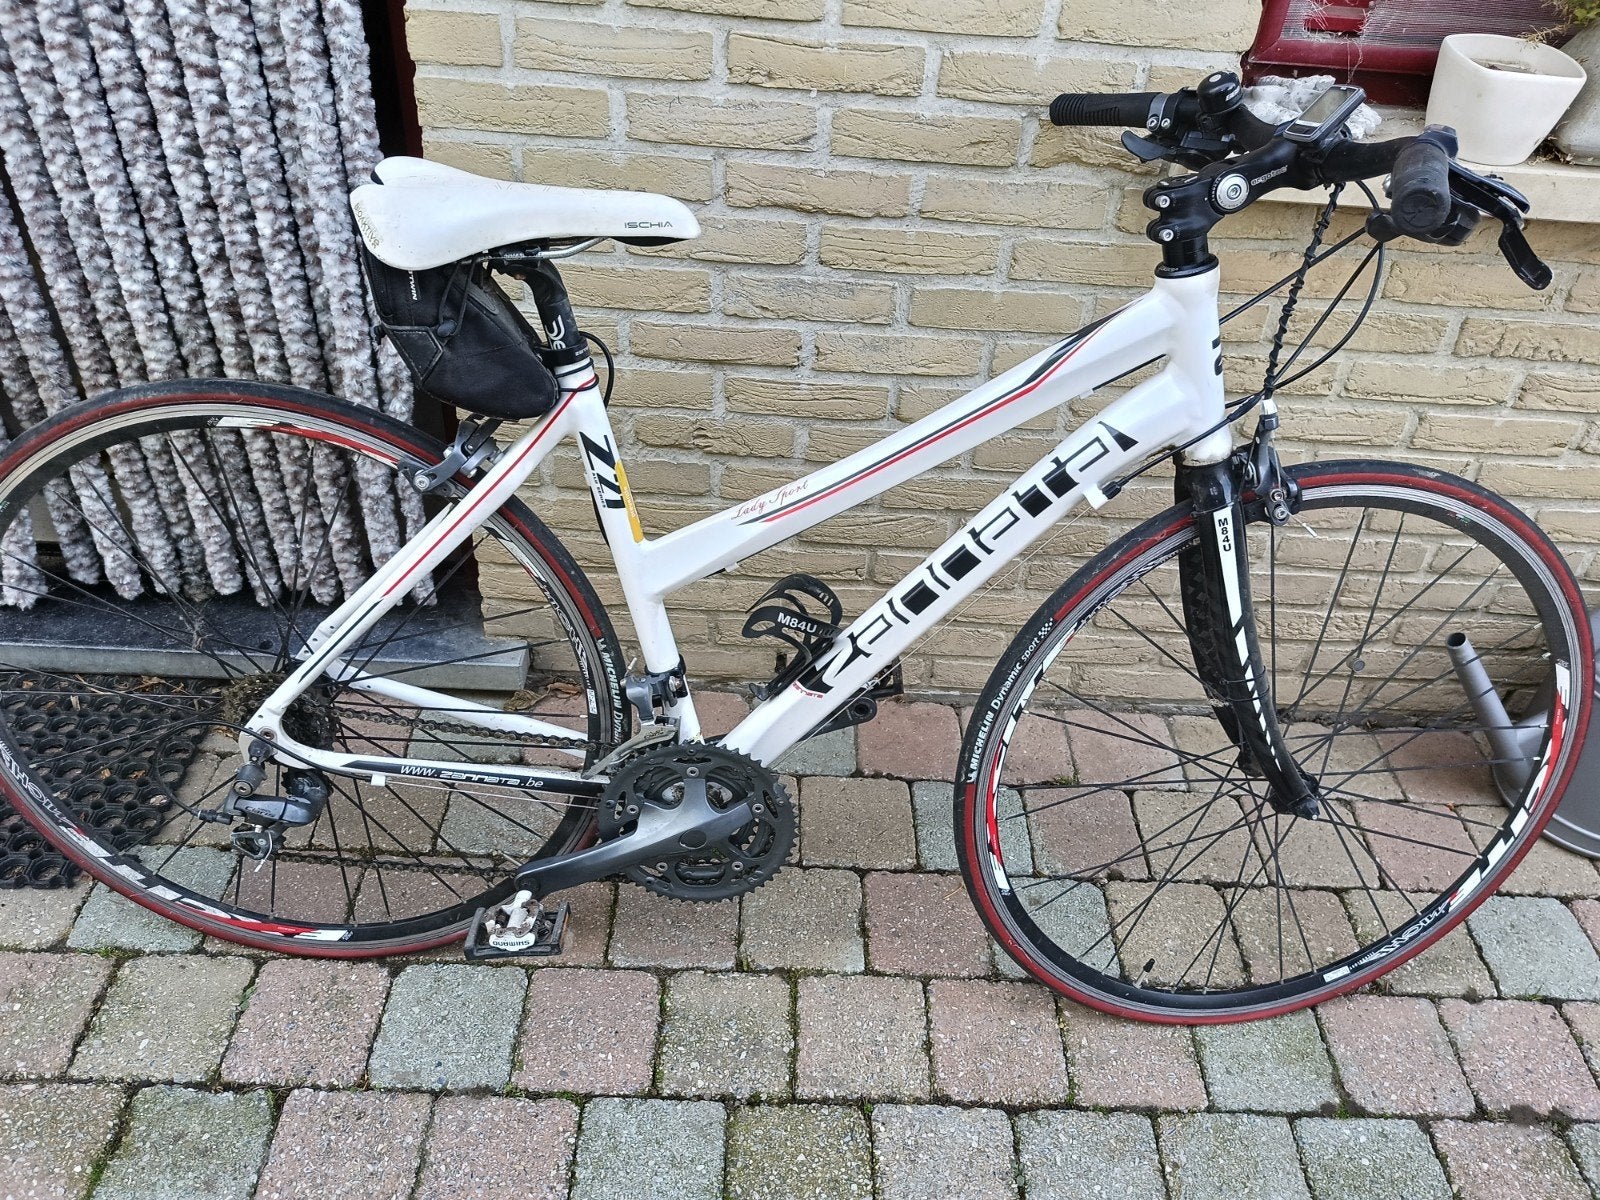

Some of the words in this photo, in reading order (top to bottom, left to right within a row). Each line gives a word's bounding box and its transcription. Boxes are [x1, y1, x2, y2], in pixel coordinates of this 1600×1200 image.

[624, 221, 673, 229] ISCHIA
[730, 499, 767, 520] Lady
[768, 479, 809, 505] Sport
[1217, 518, 1232, 552] M84U
[776, 611, 817, 633] M84U
[602, 653, 621, 710] MICHELIN
[969, 711, 994, 773] MICHELIN
[989, 662, 1023, 710] Dynamic
[1021, 636, 1040, 662] sport
[491, 938, 531, 949] SHIMANO
